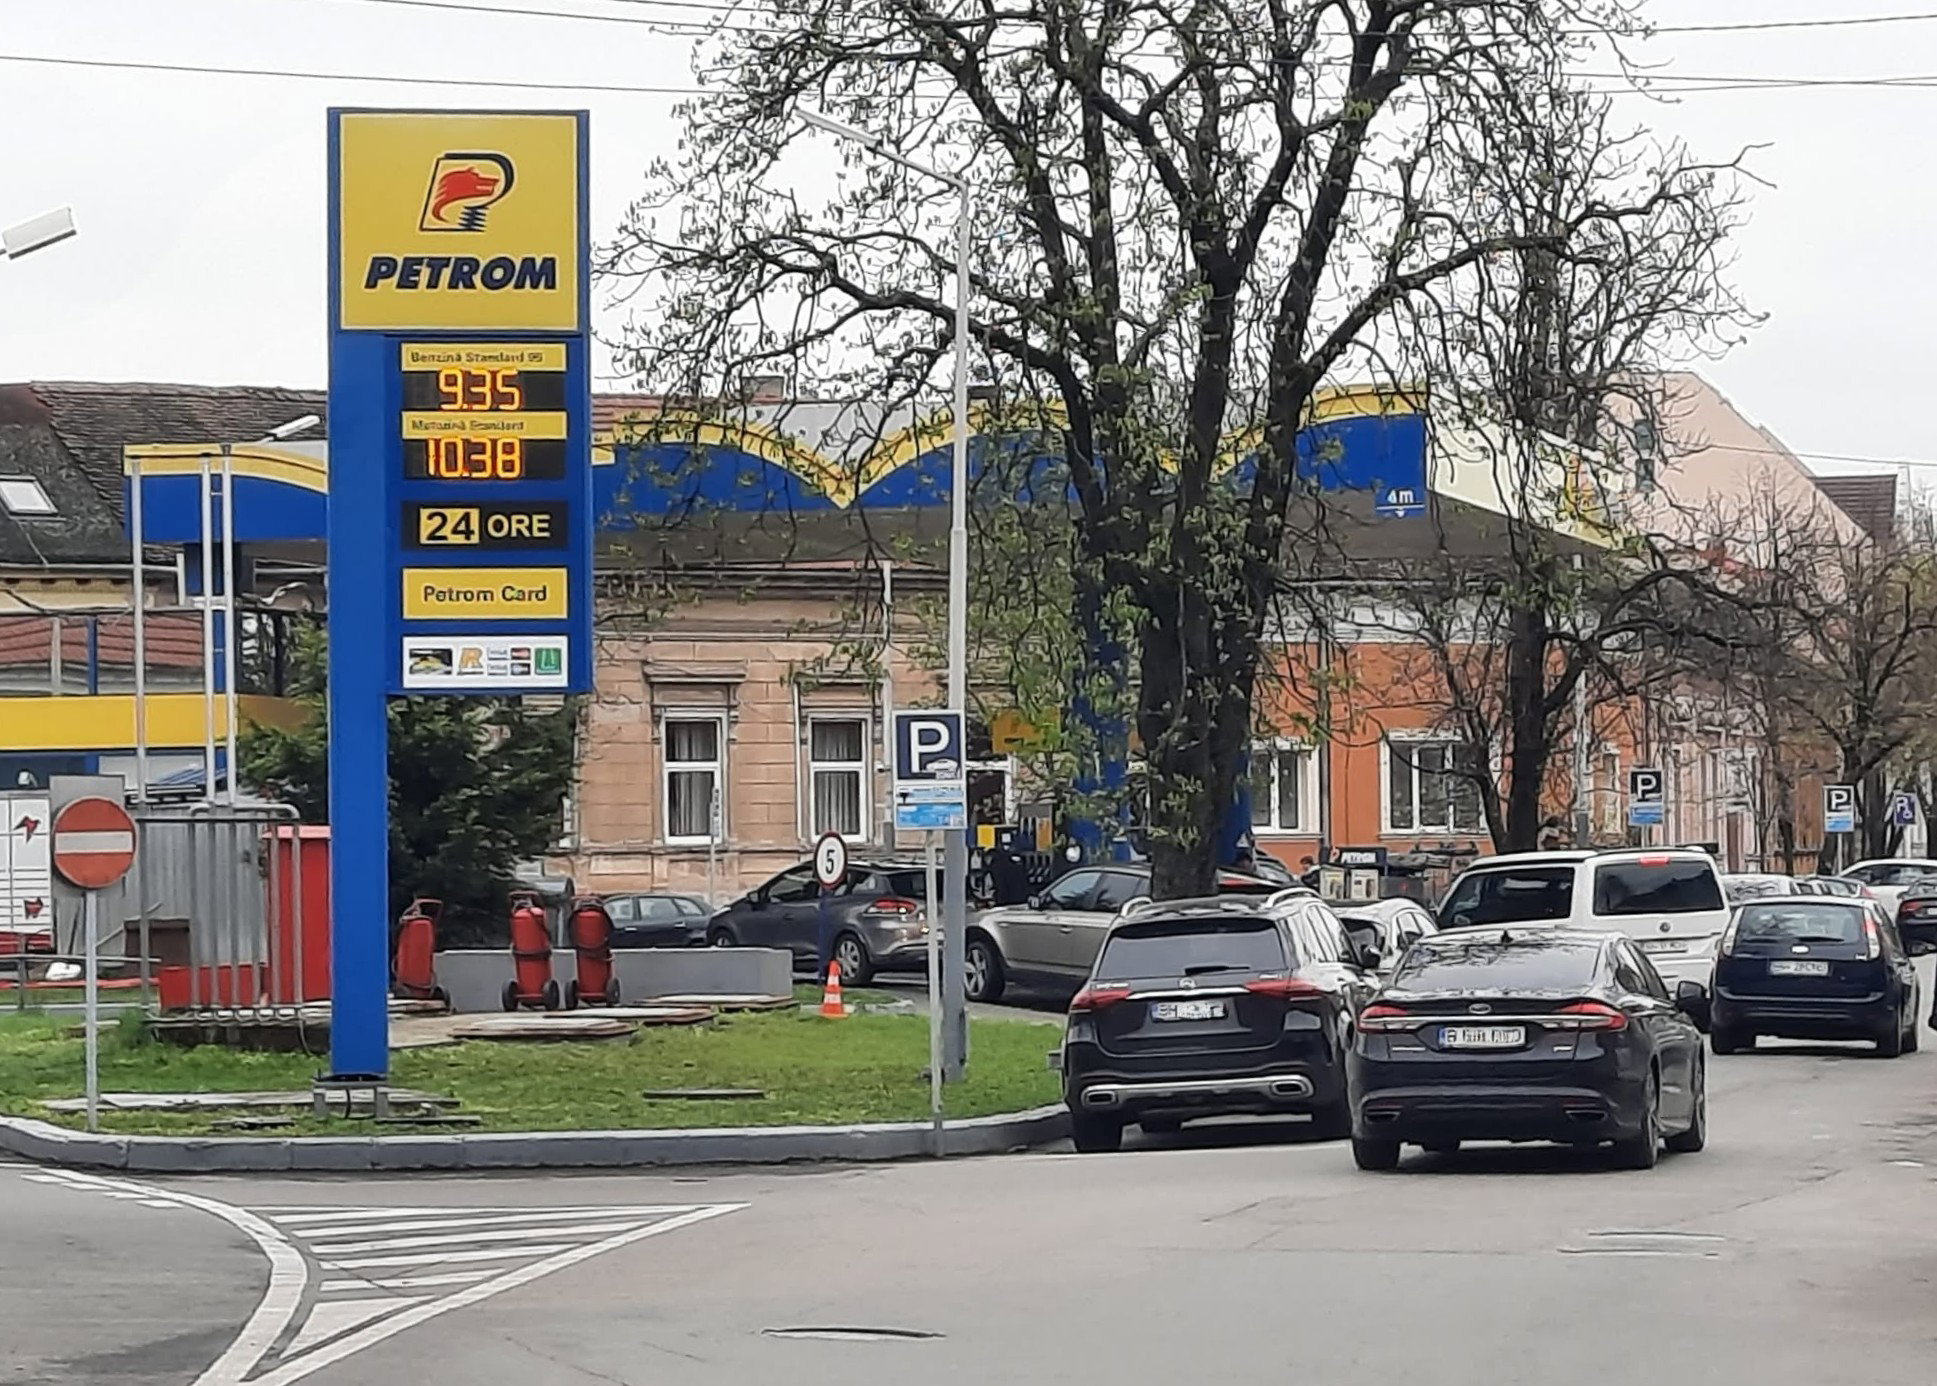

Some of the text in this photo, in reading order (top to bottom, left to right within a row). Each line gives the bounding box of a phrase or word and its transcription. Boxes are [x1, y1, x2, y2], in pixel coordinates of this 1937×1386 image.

[364, 256, 557, 291] PETROM
[465, 351, 524, 363] Standard
[425, 511, 551, 541] 24 ORE
[423, 585, 547, 602] Petrom Card
[909, 720, 949, 774] P
[1637, 774, 1656, 799] P
[1830, 790, 1847, 810] P
[825, 849, 835, 874] 5
